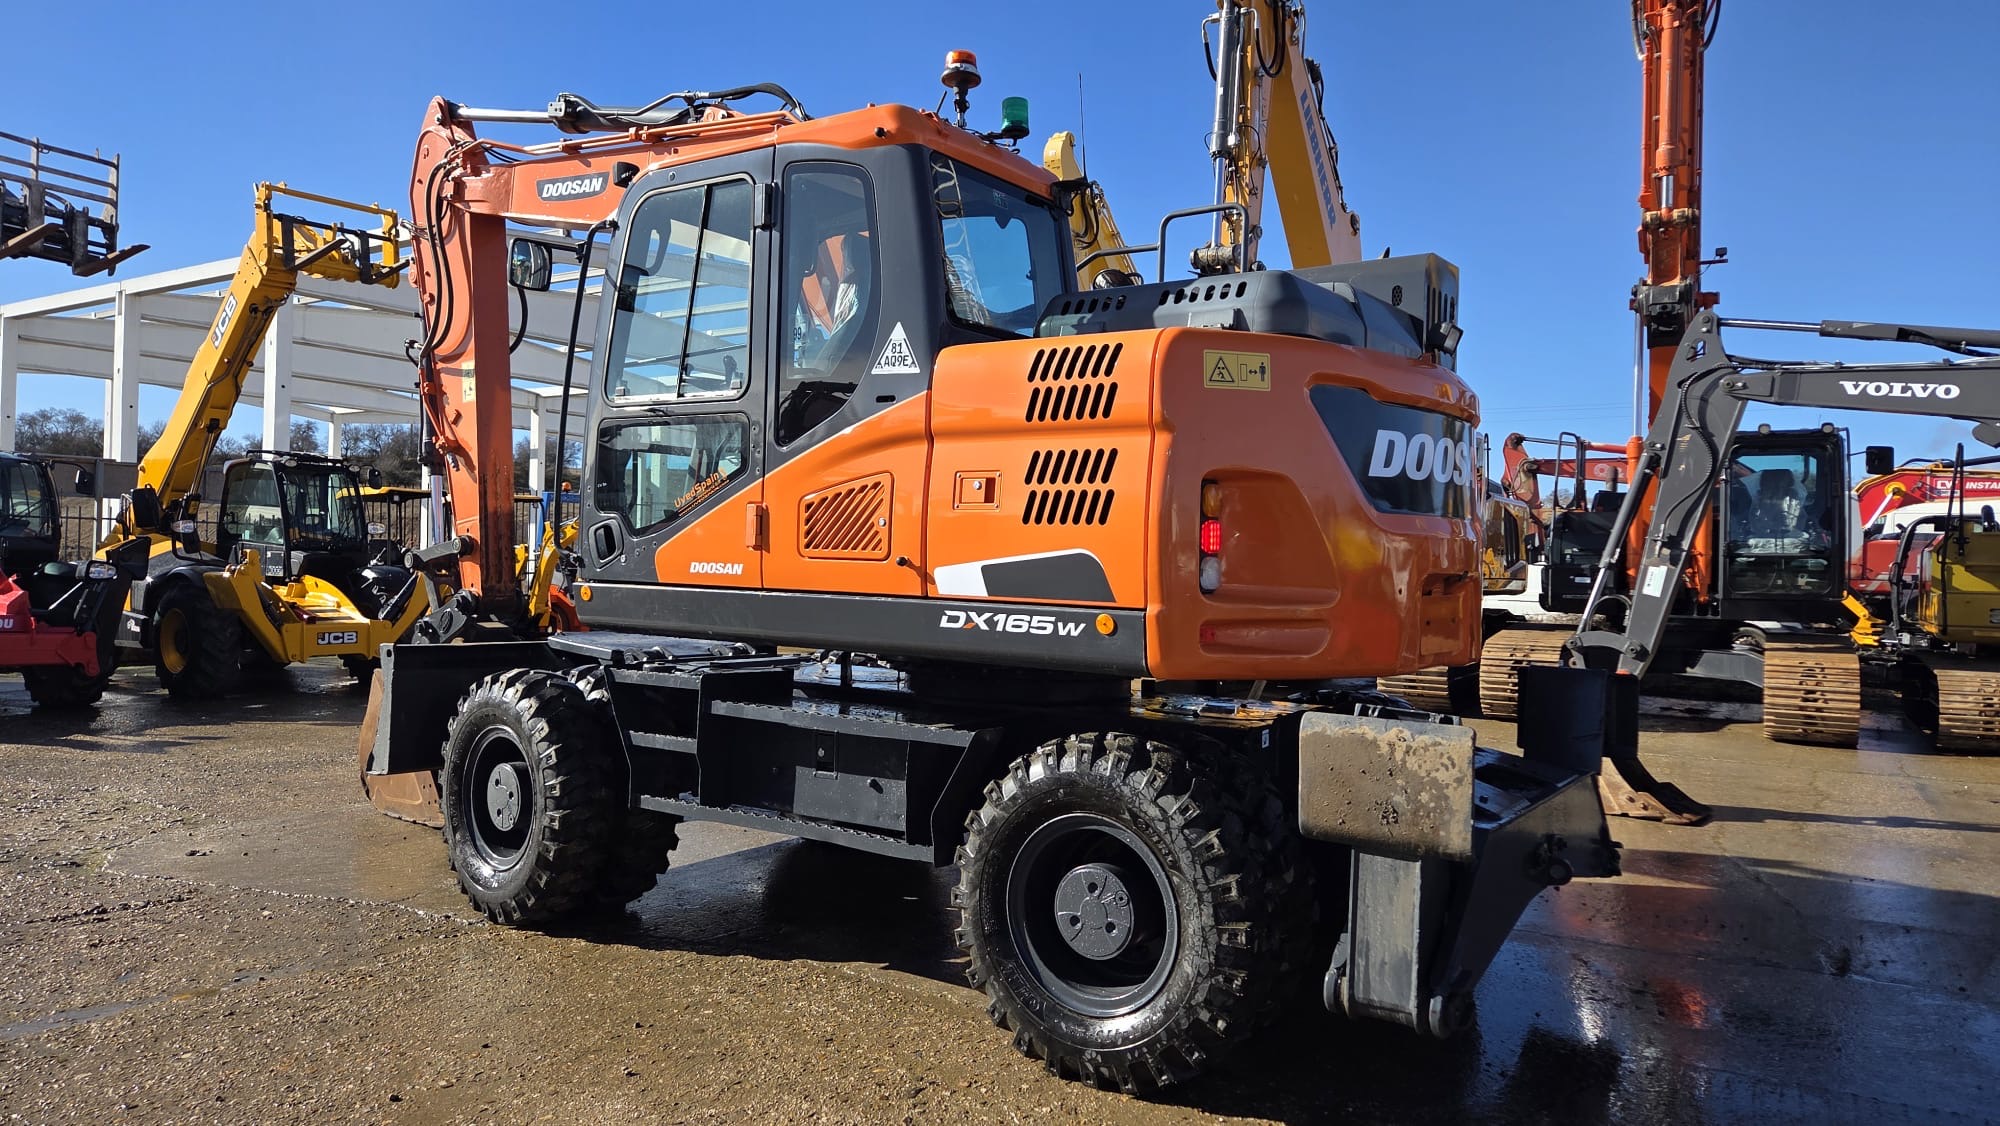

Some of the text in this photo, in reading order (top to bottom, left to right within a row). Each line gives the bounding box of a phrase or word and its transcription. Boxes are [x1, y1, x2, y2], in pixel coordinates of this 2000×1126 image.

[1300, 88, 1337, 230] LIEBHERR
[541, 177, 603, 197] DOOSAN
[211, 293, 238, 348] JCB
[891, 342, 903, 354] 81
[884, 355, 909, 367] AQ9E
[1838, 380, 1960, 399] VOLVO
[1368, 429, 1471, 487] DOOS
[674, 473, 719, 508] UvedSpain
[689, 561, 744, 575] DOOSAN
[317, 631, 357, 645] JCB
